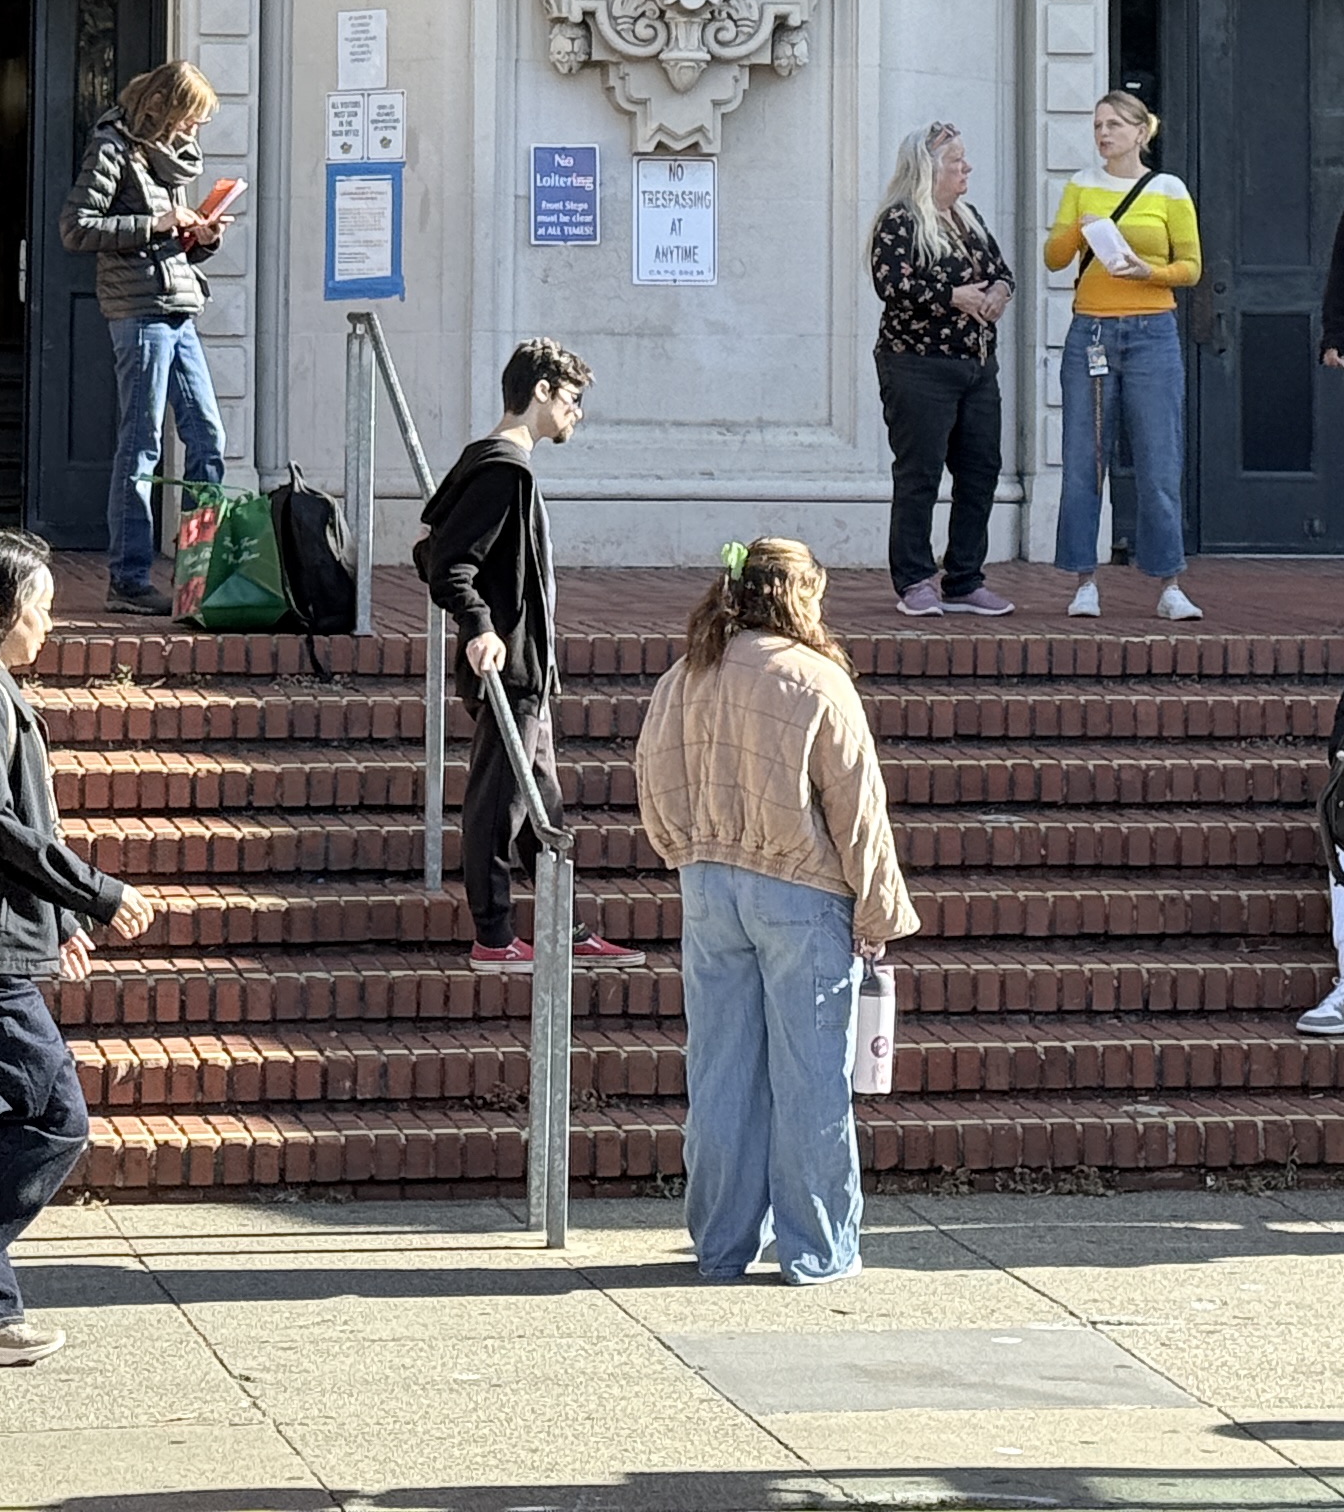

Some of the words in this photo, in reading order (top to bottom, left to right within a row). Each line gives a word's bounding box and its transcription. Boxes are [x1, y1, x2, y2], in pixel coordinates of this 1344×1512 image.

[554, 153, 574, 167] No
[536, 172, 594, 191] Loitering
[668, 163, 684, 182] NO
[541, 200, 563, 210] Front
[565, 200, 588, 212] Steps
[641, 190, 712, 209] TRESPASSING
[537, 213, 557, 223] must
[559, 212, 570, 222] be
[572, 213, 593, 222] clear
[669, 217, 683, 236] AT
[547, 226, 561, 235] ALL
[654, 244, 699, 264] ANYTIME
